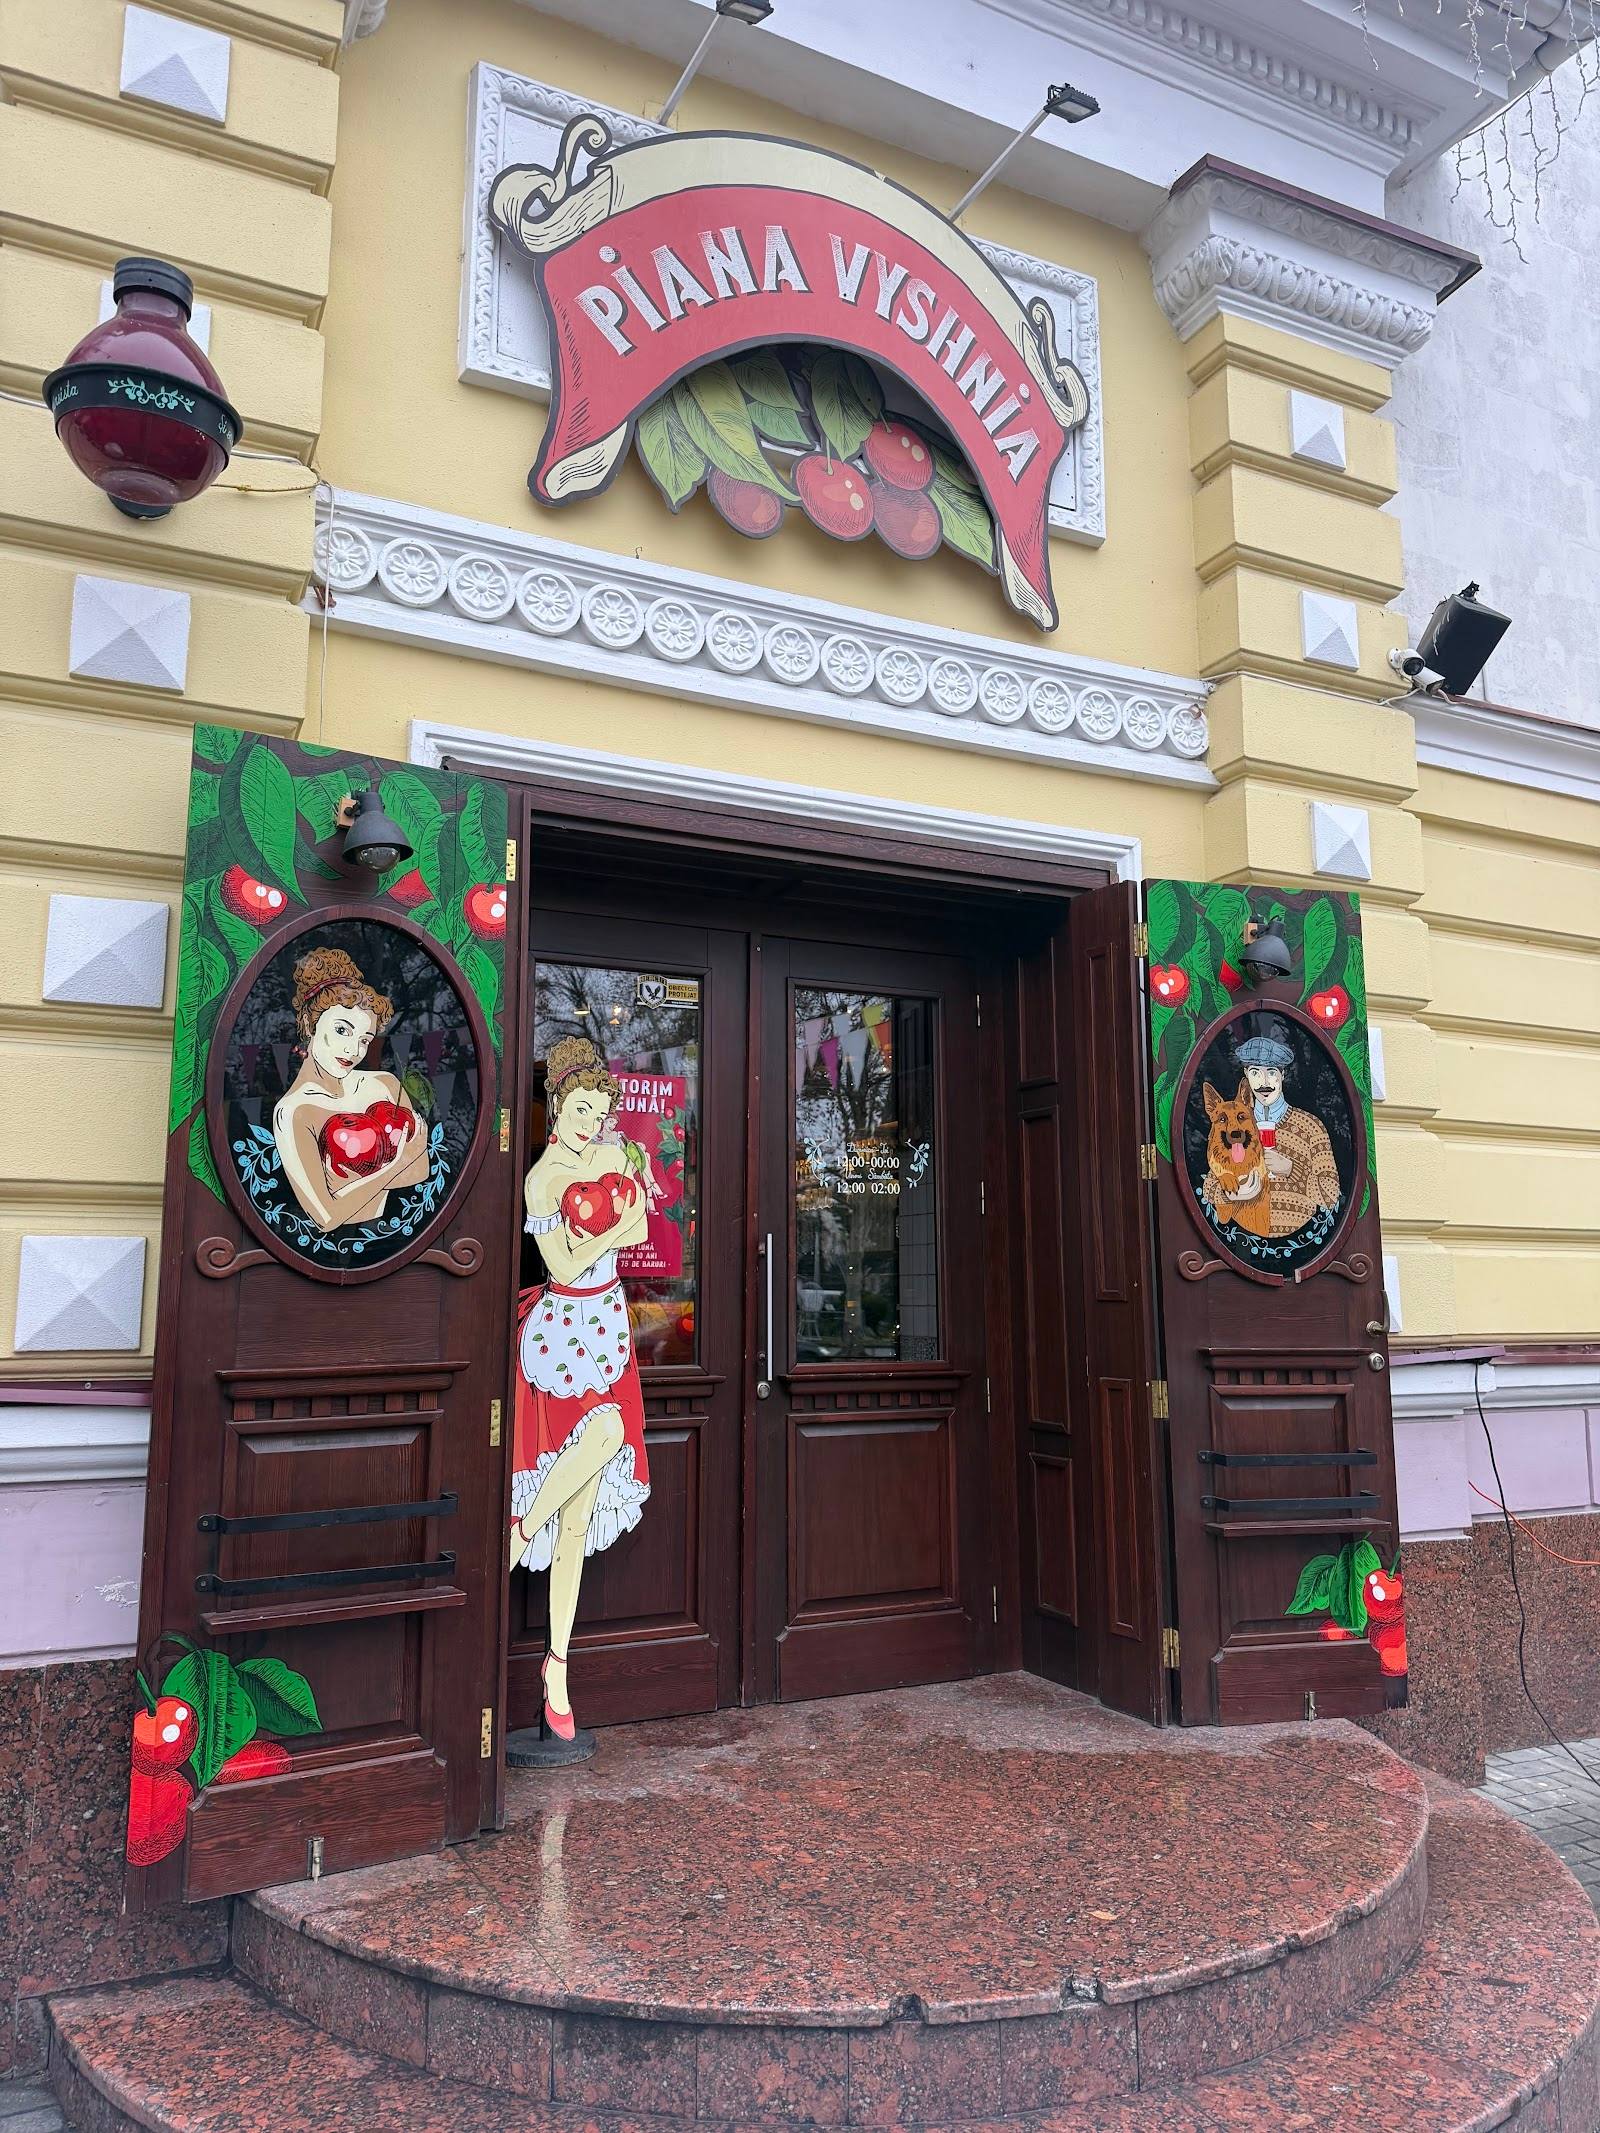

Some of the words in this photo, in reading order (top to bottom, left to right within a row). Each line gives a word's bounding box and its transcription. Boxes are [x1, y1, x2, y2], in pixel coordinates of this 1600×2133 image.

[612, 1075, 672, 1096] TORIM
[616, 1095, 665, 1113] EUNĂ!
[837, 1182, 866, 1194] 12:00
[871, 1182, 900, 1194] 02:00
[638, 1242, 654, 1251] LUNĂ
[621, 1260, 629, 1268] 75
[632, 1260, 640, 1268] DE
[642, 1260, 666, 1268] BARURI
